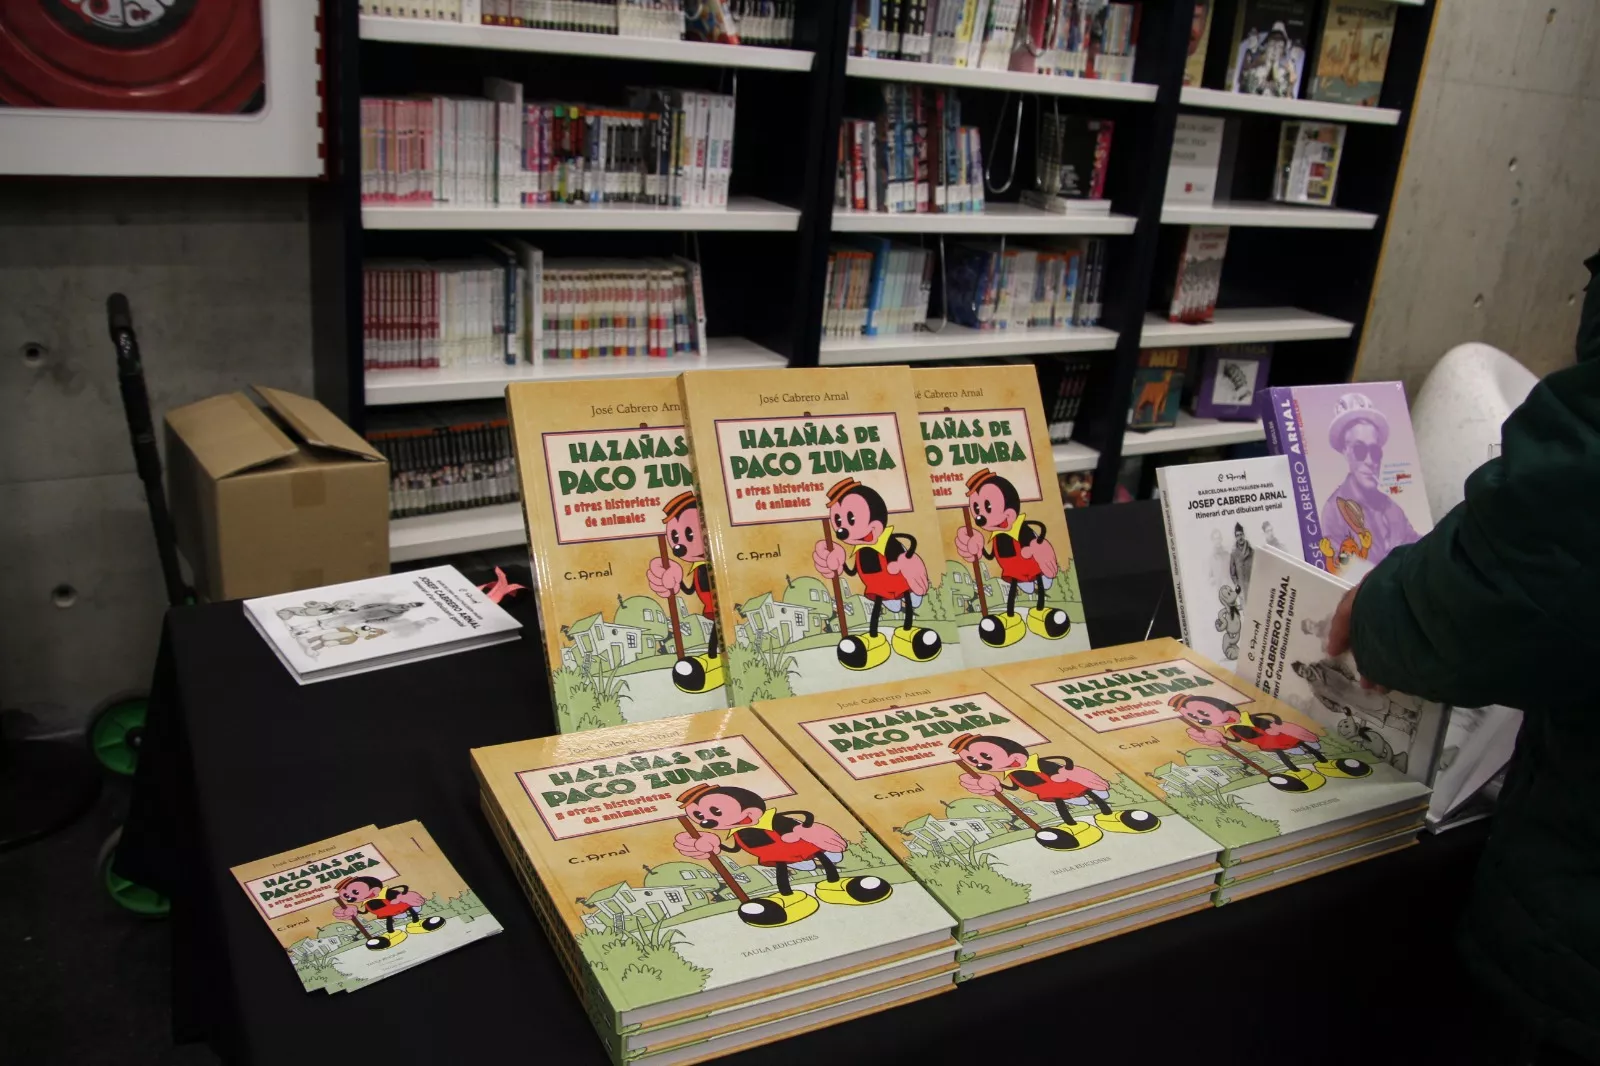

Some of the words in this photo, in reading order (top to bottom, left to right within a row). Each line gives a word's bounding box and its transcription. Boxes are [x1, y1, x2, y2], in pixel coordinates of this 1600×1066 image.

[759, 394, 779, 406] José
[782, 393, 820, 403] Cabrero
[823, 391, 850, 402] Arnal
[924, 389, 958, 400] Cabrero
[960, 388, 984, 397] Arnal
[591, 405, 614, 417] José
[616, 403, 658, 414] Cabrero
[662, 402, 681, 411] Arn
[739, 422, 849, 449] HAZAÑAS
[853, 426, 880, 444] DE
[988, 420, 1012, 437] DE
[1281, 399, 1302, 454] ARNAL
[568, 434, 689, 463] HAZAÑAS
[925, 445, 943, 467] O
[948, 441, 1027, 466] ZUMBA
[729, 452, 802, 480] PACO
[808, 447, 897, 475] ZUMBA
[558, 466, 636, 495] PACO
[644, 463, 694, 489] ZUM
[745, 483, 771, 496] otras
[773, 481, 825, 495] historietas
[929, 473, 964, 484] torietas
[574, 500, 603, 512] otras
[604, 497, 660, 510] historietas
[755, 499, 767, 510] de
[769, 497, 811, 510] animales
[1188, 498, 1215, 511] JOSEP
[1216, 494, 1258, 507] CABRERO
[1259, 490, 1287, 500] ARNAL
[1294, 460, 1318, 536] CABRERO
[585, 516, 598, 528] de
[600, 513, 646, 526] animales
[1195, 509, 1221, 520] Itinerari
[1236, 504, 1265, 515] dibuixant
[1265, 502, 1283, 512] genial
[750, 544, 782, 561] Arnal
[1309, 542, 1325, 571] OSÉ
[579, 562, 613, 580] Arnal
[418, 576, 438, 590] JOSEP
[434, 589, 463, 612] CABRERO
[459, 612, 481, 629] ARNAL
[1176, 582, 1184, 604] ARNAL
[1276, 575, 1290, 619] ARNAL
[1288, 588, 1297, 617] genial
[1180, 605, 1189, 636] CABRERO
[1265, 620, 1282, 679] CABRERO
[1280, 618, 1292, 659] dibuixant
[1058, 670, 1159, 695] HAZAÑAS
[1157, 666, 1186, 677] DE
[1276, 660, 1284, 680] d'un
[1062, 689, 1132, 710] PACO
[1131, 675, 1215, 699] ZUMBA
[1262, 680, 1271, 695] EP
[1273, 680, 1281, 699] rari
[837, 699, 859, 710] José
[861, 693, 902, 706] Cabrero
[903, 688, 932, 699] Arnal
[1092, 706, 1116, 718] otras
[1117, 699, 1163, 713] historietas
[828, 705, 949, 735] HAZAÑAS
[950, 702, 982, 715] DE
[1108, 714, 1121, 722] de
[1121, 708, 1159, 721] animales
[828, 729, 910, 753] PACO
[912, 712, 1011, 739] ZUMBA
[857, 749, 887, 762] otras
[888, 739, 944, 756] historietas
[874, 757, 887, 767] de
[888, 750, 936, 765] animales
[548, 751, 691, 786] HAZAÑAS
[697, 746, 732, 761] DE
[541, 778, 637, 808] PACO
[643, 757, 760, 790] ZUMBA
[888, 783, 925, 798] Arnal
[566, 804, 602, 818] otras
[604, 792, 673, 810] historietas
[583, 815, 600, 825] de
[602, 805, 658, 822] animales
[585, 844, 630, 863] Arnal
[259, 879, 313, 902] PACO
[315, 857, 381, 884] ZUMBA
[262, 858, 342, 888] HAZAÑAS
[345, 851, 365, 863] DE
[274, 895, 294, 906] otras
[294, 884, 332, 899] historietas
[294, 893, 325, 906] animales
[741, 946, 772, 958] TAULA
[772, 934, 820, 950] EDICIONES
